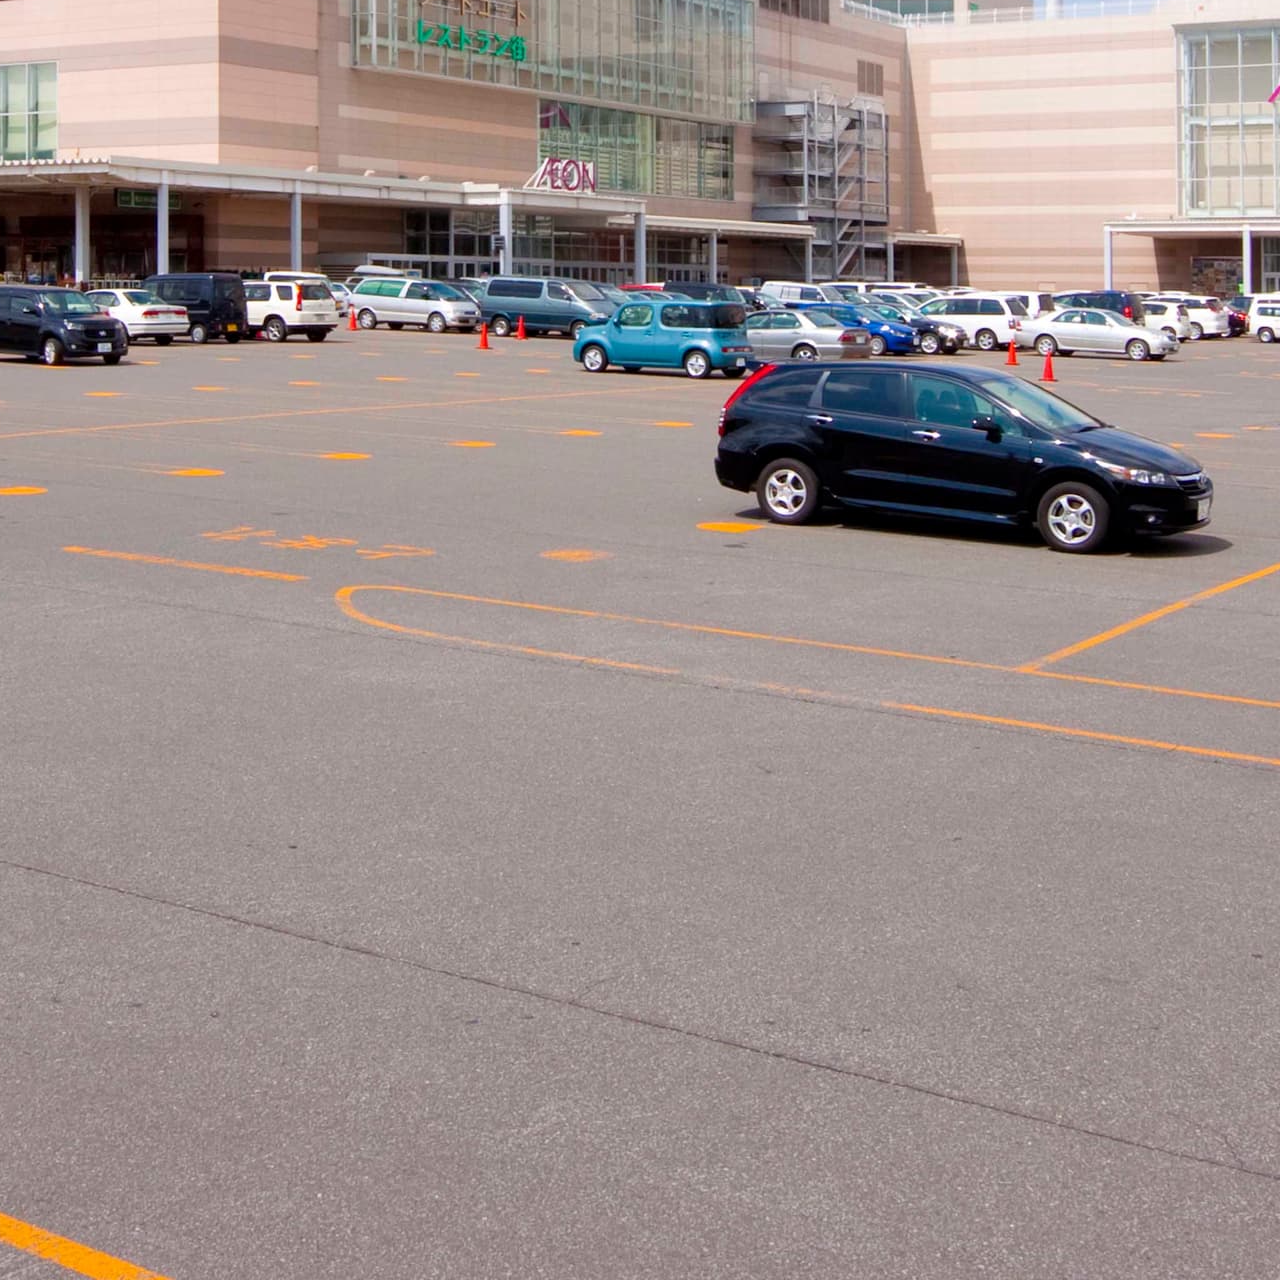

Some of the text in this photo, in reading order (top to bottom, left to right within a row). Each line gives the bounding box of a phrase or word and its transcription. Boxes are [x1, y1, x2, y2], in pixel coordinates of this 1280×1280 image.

[417, 18, 527, 61] レストラン街
